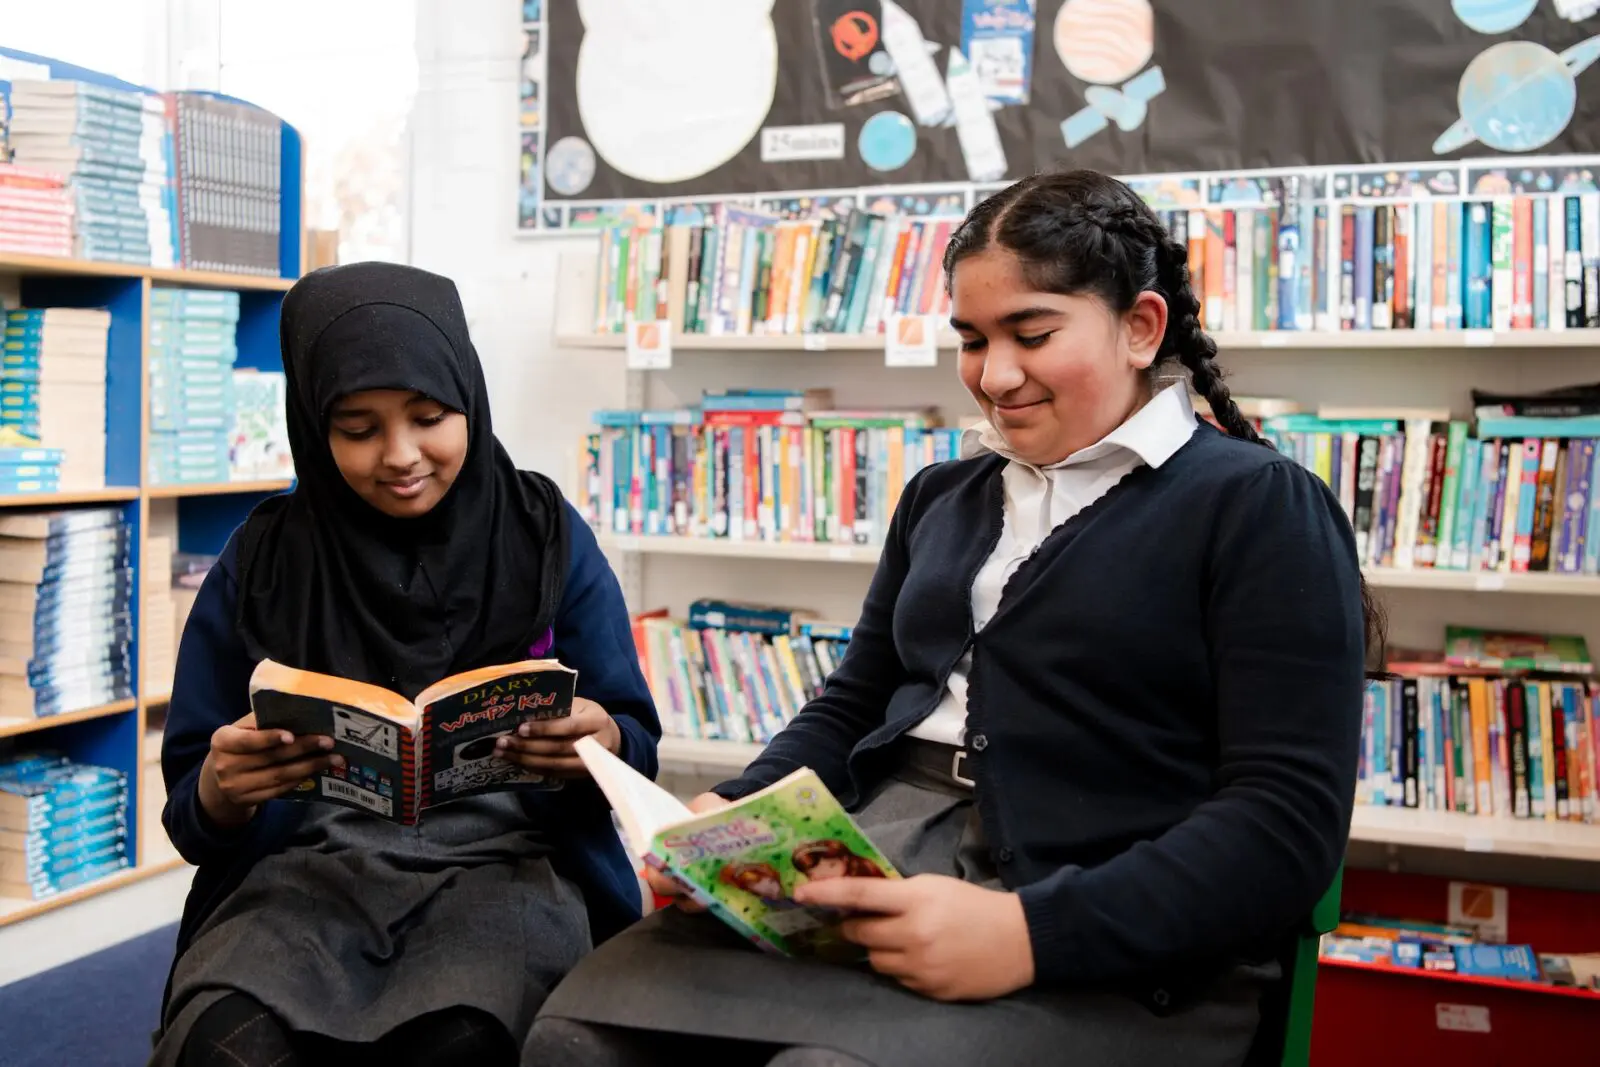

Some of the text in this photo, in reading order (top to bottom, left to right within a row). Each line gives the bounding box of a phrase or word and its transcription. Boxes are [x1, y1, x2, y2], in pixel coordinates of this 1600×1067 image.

[463, 677, 538, 705] DIARY
[439, 701, 516, 732] Wimpy
[517, 691, 557, 711] Kid
